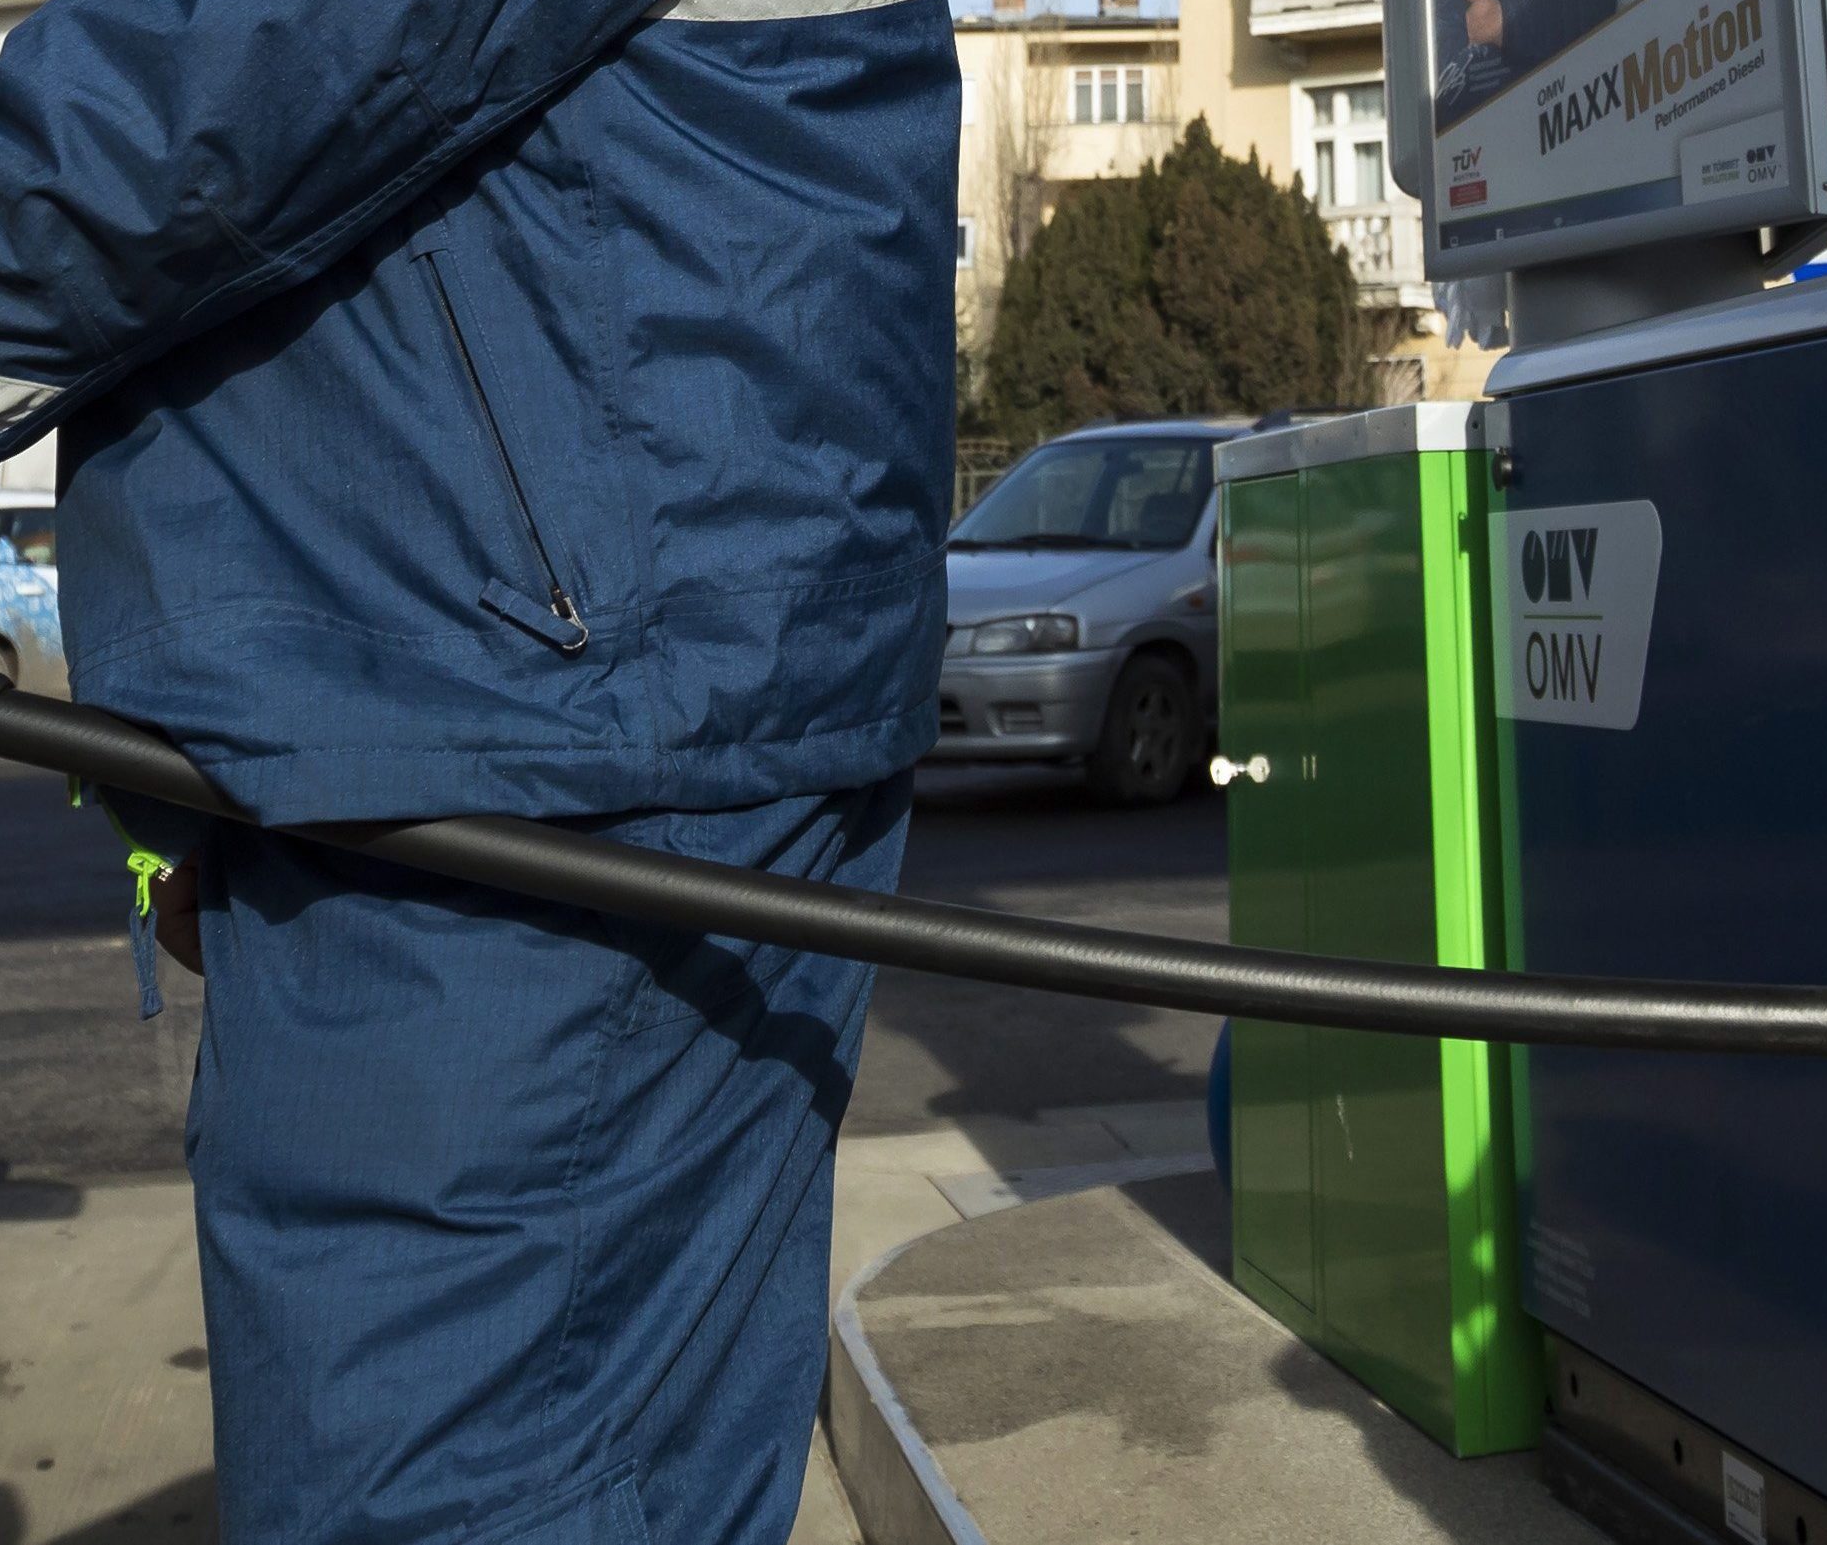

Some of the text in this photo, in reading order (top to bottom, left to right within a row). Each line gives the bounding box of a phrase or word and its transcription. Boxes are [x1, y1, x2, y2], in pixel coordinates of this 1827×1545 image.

[1536, 74, 1566, 107] OMV
[1655, 49, 1765, 131] Performance Diesel
[1748, 165, 1778, 183] OMV
[1527, 631, 1602, 704] OMV
